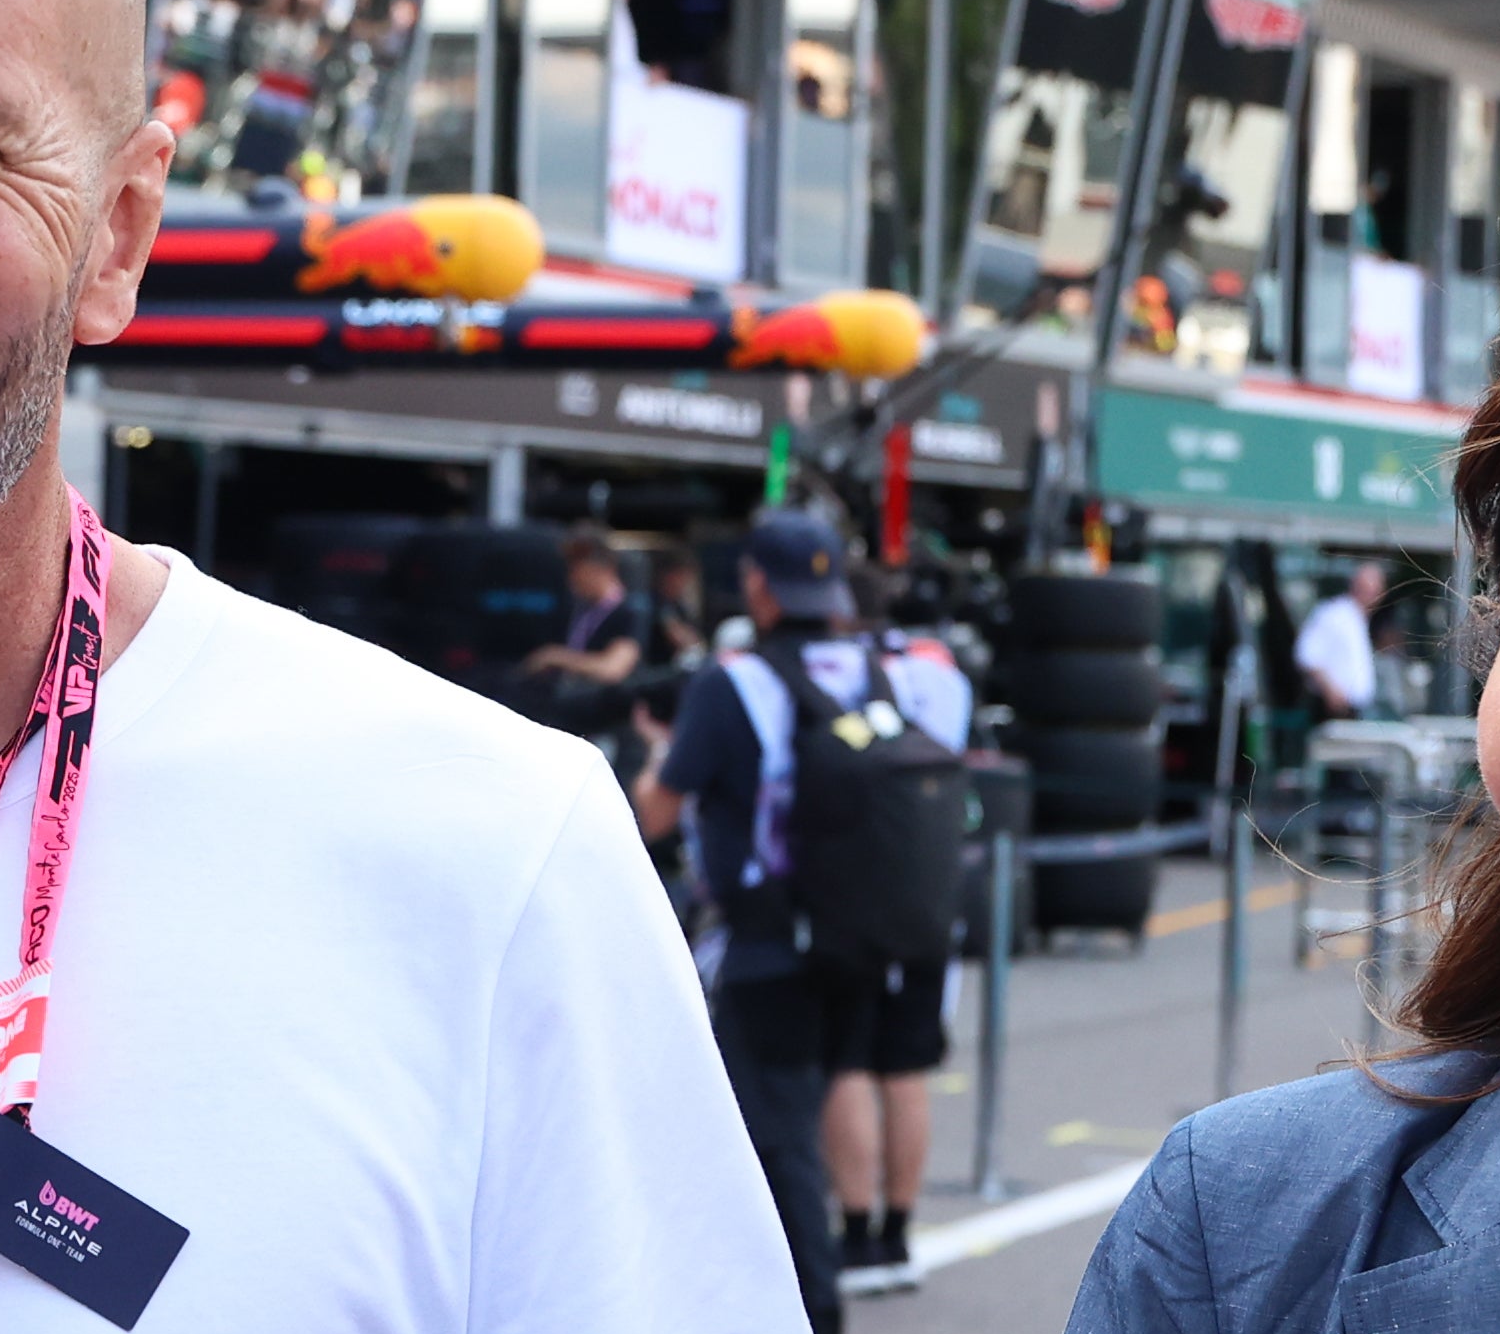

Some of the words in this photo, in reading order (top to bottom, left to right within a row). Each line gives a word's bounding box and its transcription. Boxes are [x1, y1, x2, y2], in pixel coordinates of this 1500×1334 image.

[78, 623, 100, 670] Guest
[62, 666, 95, 716] VIP
[62, 770, 79, 802] 2025
[47, 800, 72, 851] Carlo
[32, 843, 63, 900] Monte
[13, 1197, 103, 1259] ALPINE
[55, 1192, 99, 1230] BWT
[12, 1213, 49, 1240] FORMULA
[63, 1245, 87, 1264] TEAM
